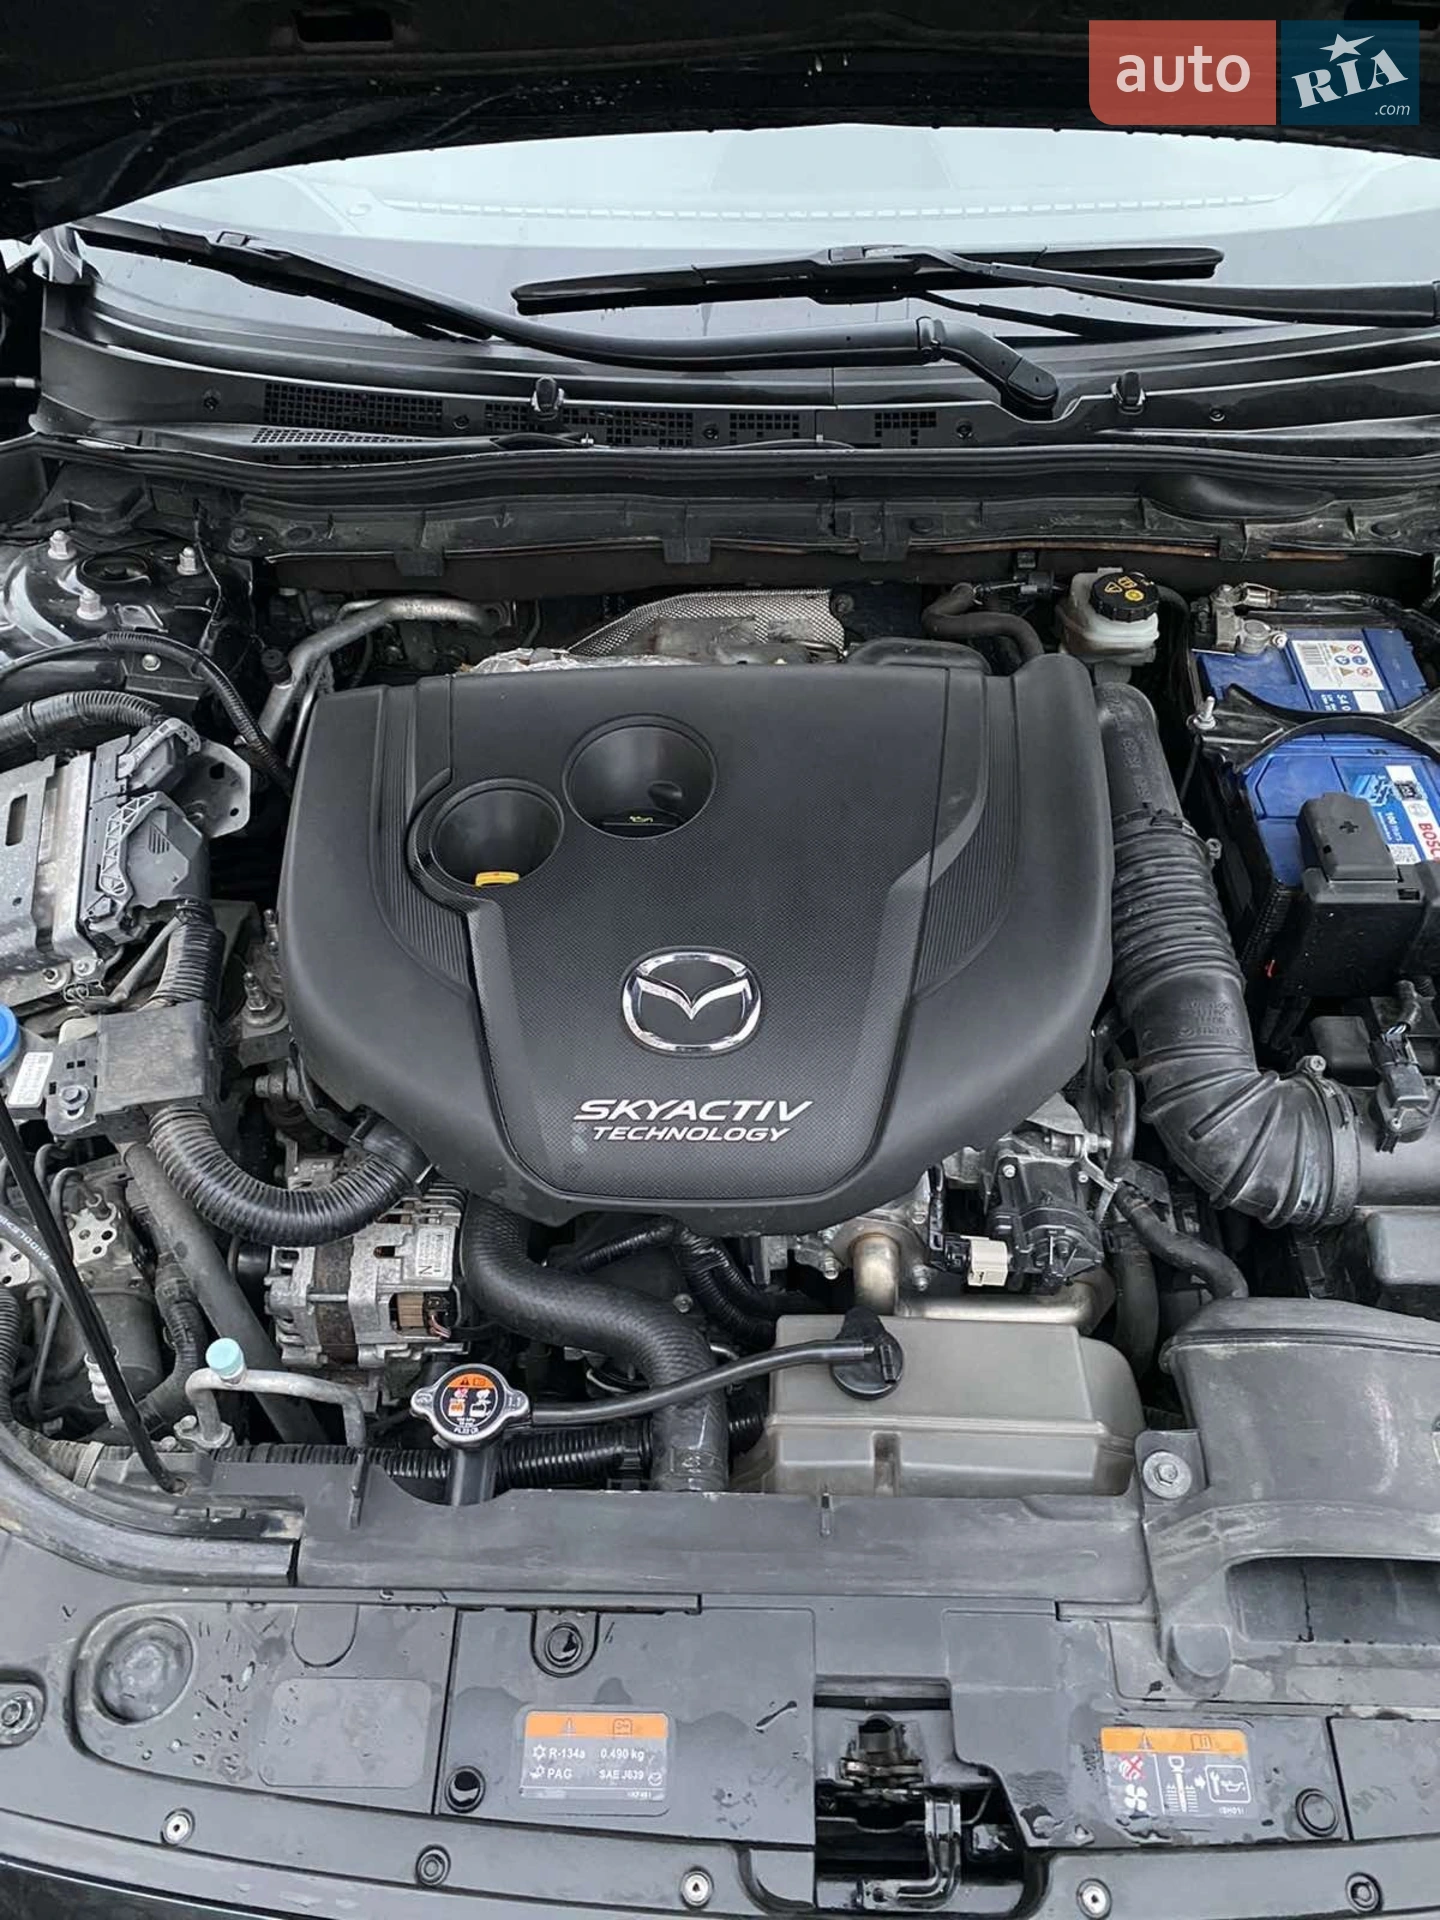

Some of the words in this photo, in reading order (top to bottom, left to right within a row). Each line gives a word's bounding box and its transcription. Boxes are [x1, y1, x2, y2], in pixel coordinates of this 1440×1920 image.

[1418, 822, 1440, 863] BOSC
[573, 1100, 813, 1121] SKYACTIV
[593, 1127, 790, 1141] TECHNOLOGY
[549, 1747, 585, 1759] R-134a
[600, 1748, 629, 1759] 0.490
[631, 1748, 645, 1761] kg
[547, 1768, 573, 1779] PAG
[599, 1769, 620, 1779] SAE
